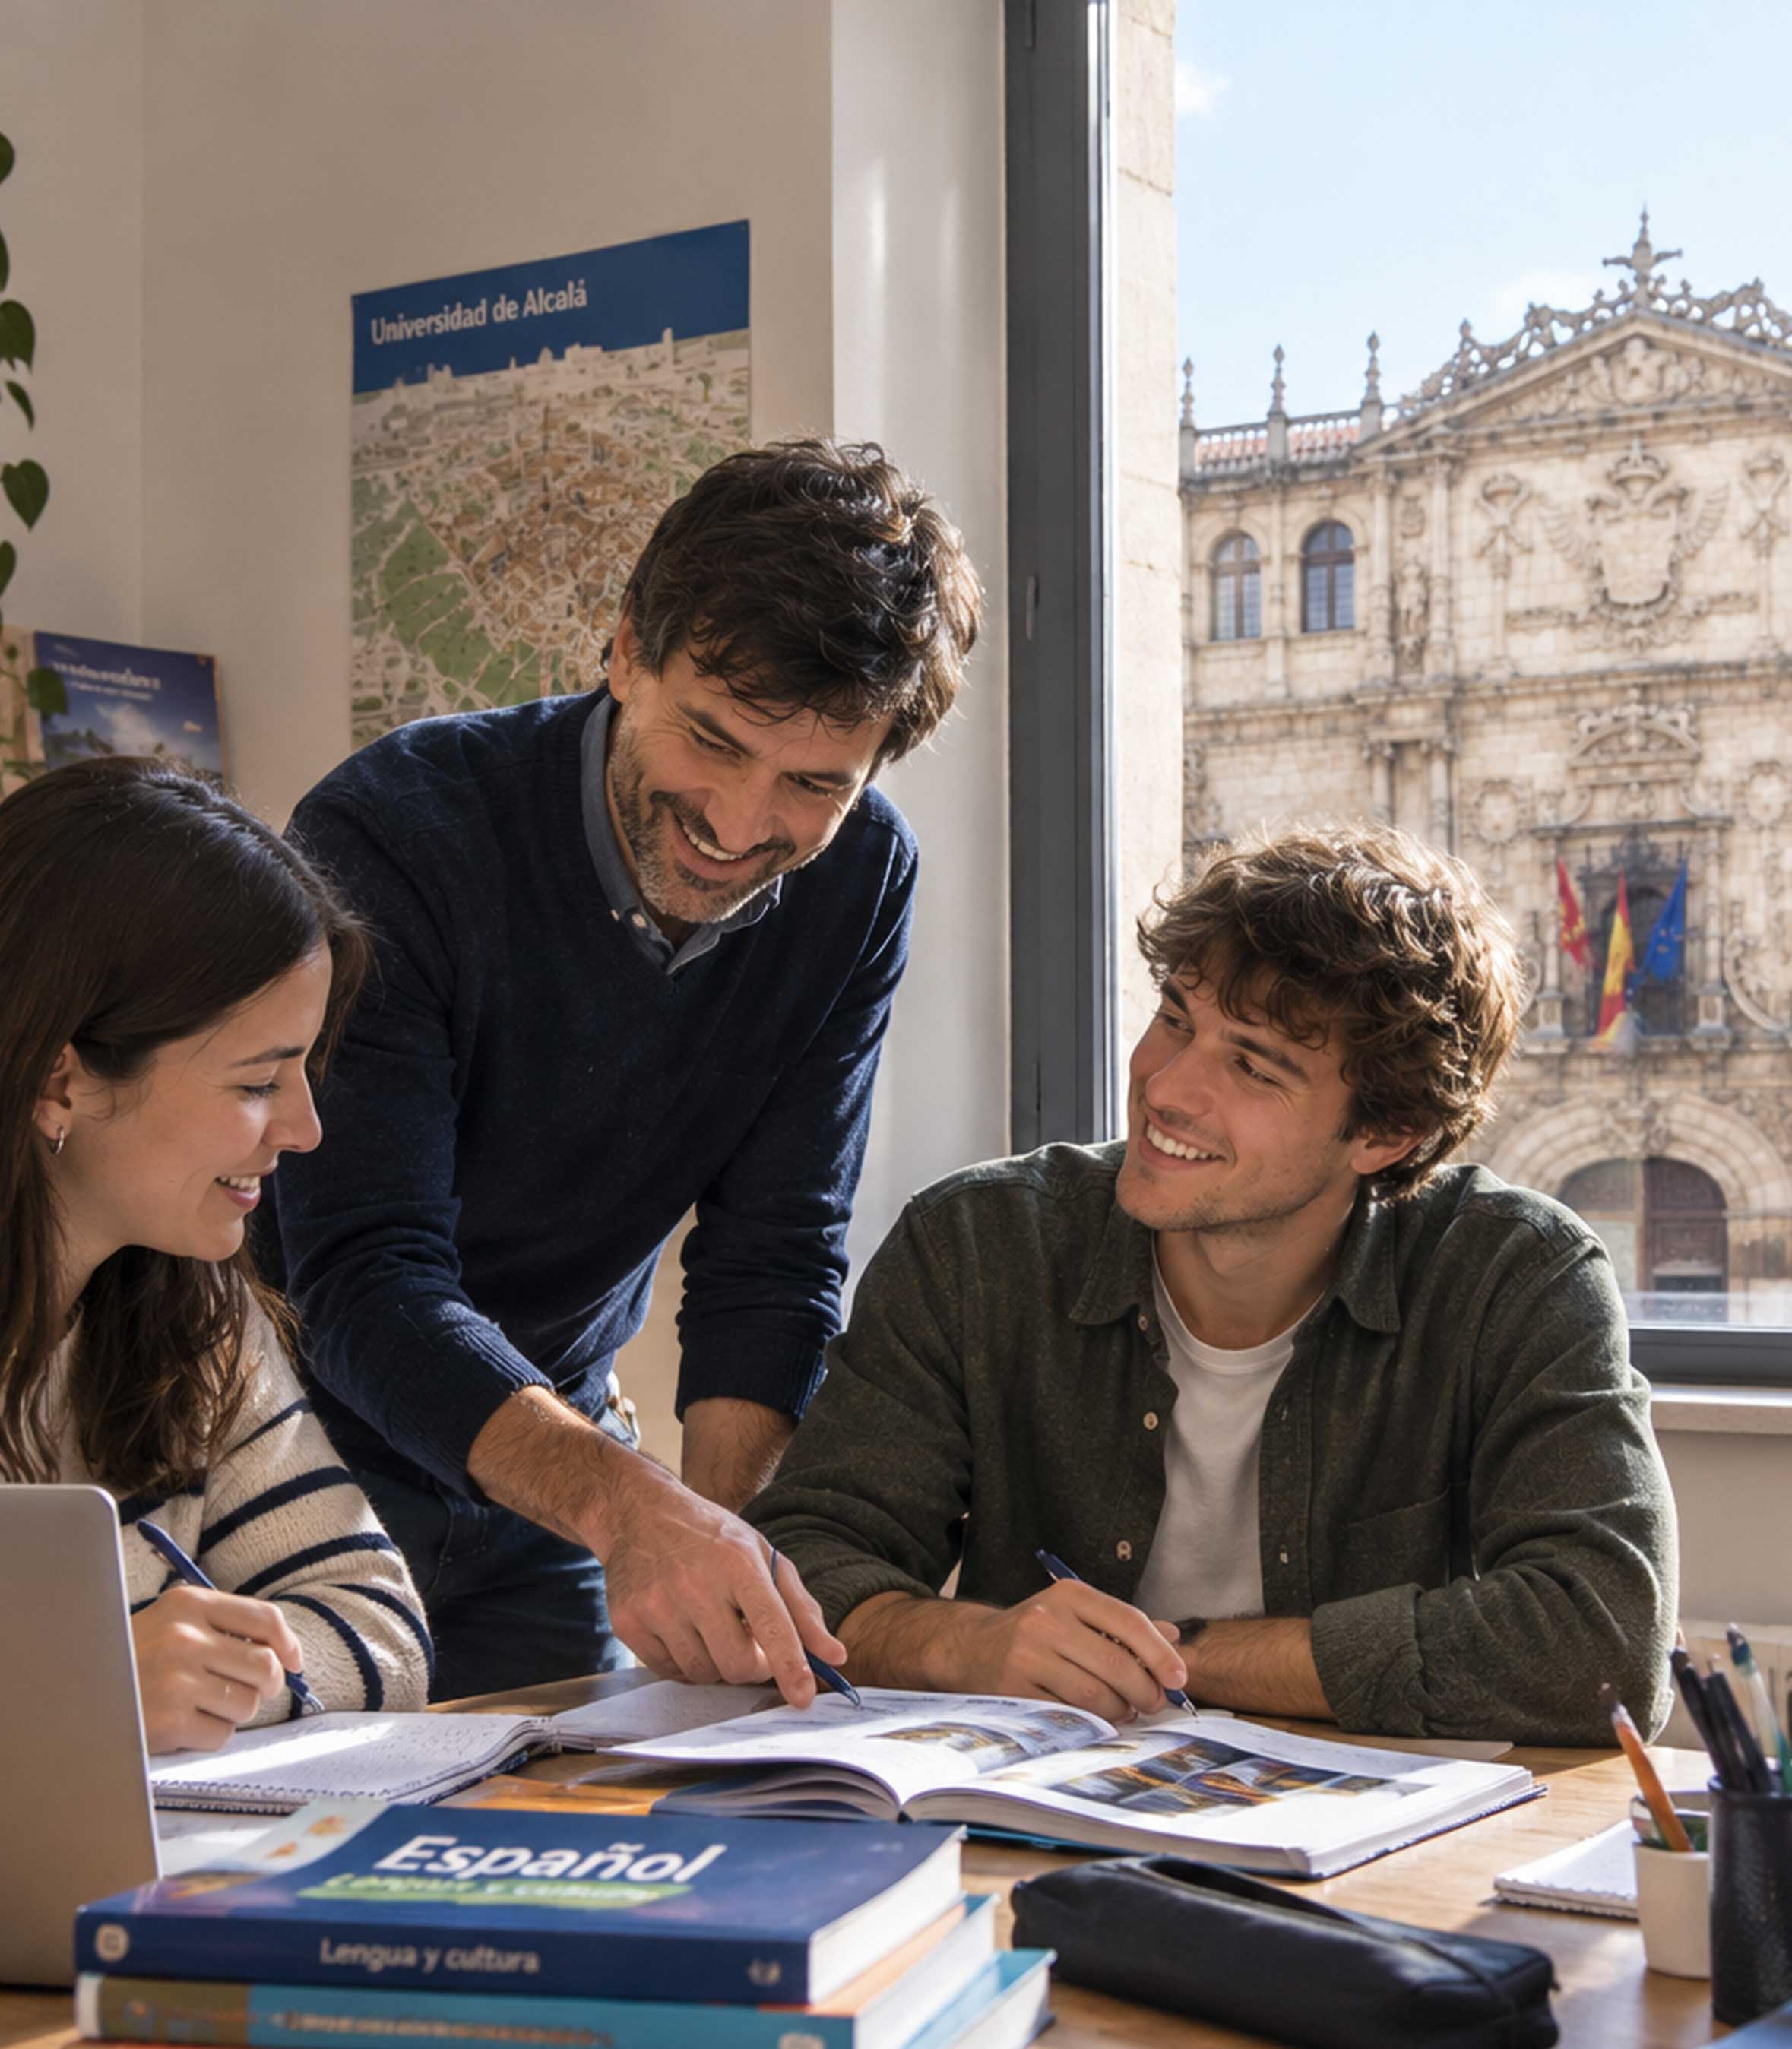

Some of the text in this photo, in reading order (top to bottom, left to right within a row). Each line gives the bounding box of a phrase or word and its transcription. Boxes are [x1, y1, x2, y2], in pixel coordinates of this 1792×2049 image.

[371, 278, 587, 344] Universidad de Alcalá
[375, 1835, 727, 1881] Español
[320, 1937, 540, 1974] Lengua y cultura
